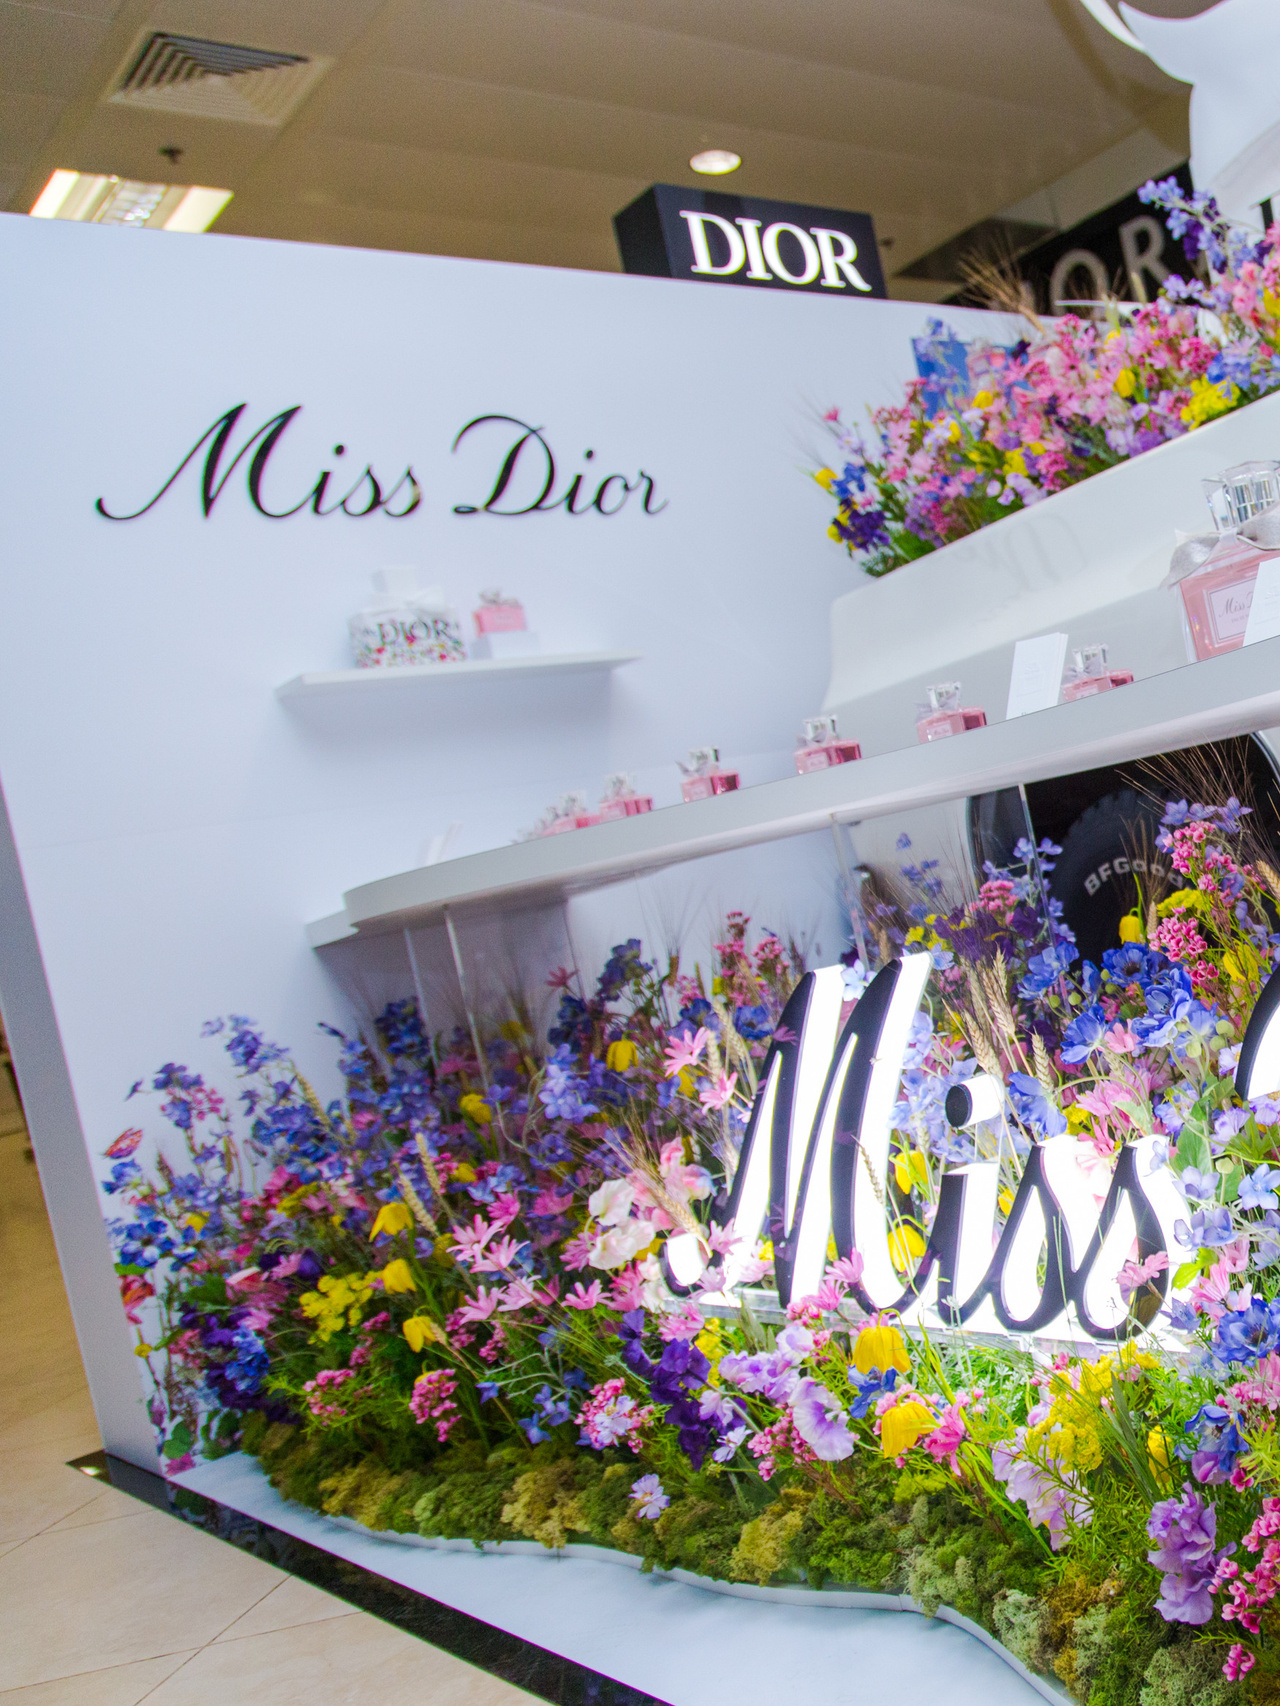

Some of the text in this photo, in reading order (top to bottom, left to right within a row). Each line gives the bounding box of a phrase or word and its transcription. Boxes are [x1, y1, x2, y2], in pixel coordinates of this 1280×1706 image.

[679, 209, 873, 293] DIOR
[95, 402, 668, 523] Miss Dior
[376, 618, 457, 646] DIOR
[661, 951, 1188, 1342] Miss
